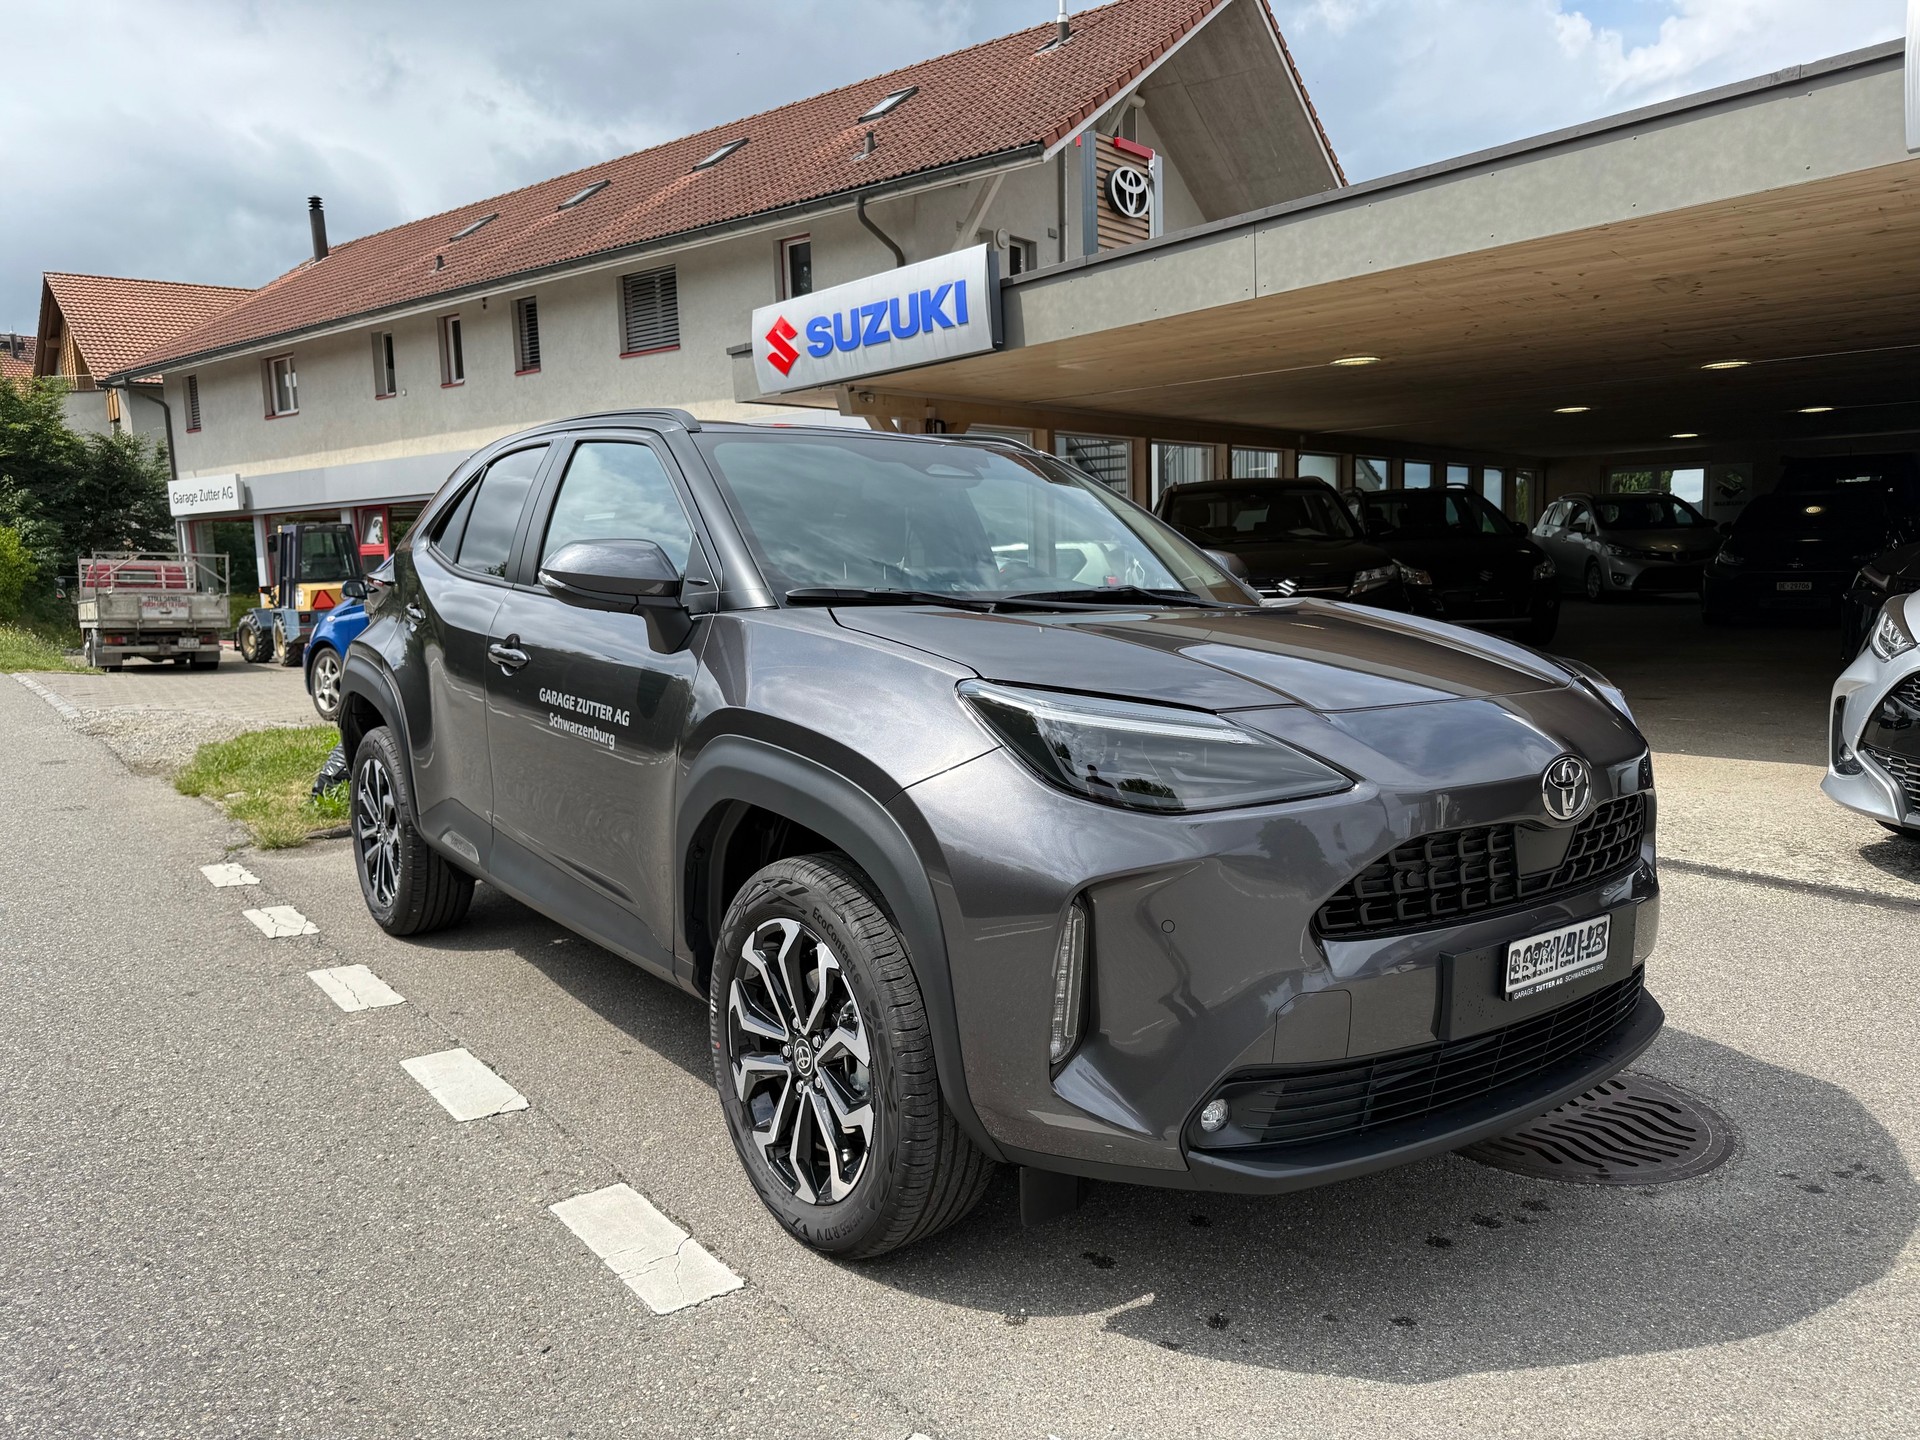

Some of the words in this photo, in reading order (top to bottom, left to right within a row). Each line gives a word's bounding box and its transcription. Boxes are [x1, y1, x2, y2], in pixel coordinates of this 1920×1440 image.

[806, 280, 969, 358] SUZUKI
[172, 492, 198, 506] Garage
[199, 488, 220, 502] Zutter
[222, 486, 234, 500] AG
[539, 687, 576, 710] GARAGE
[576, 697, 613, 721] ZUTTER
[613, 708, 630, 726] AG
[549, 712, 616, 750] Schwarzenburg
[812, 906, 856, 974] EcoContact
[853, 973, 862, 984] 6
[1514, 988, 1534, 999] GARAGE
[1536, 980, 1556, 992] ZUTTER
[1565, 963, 1604, 982] SCHWARZENBURG
